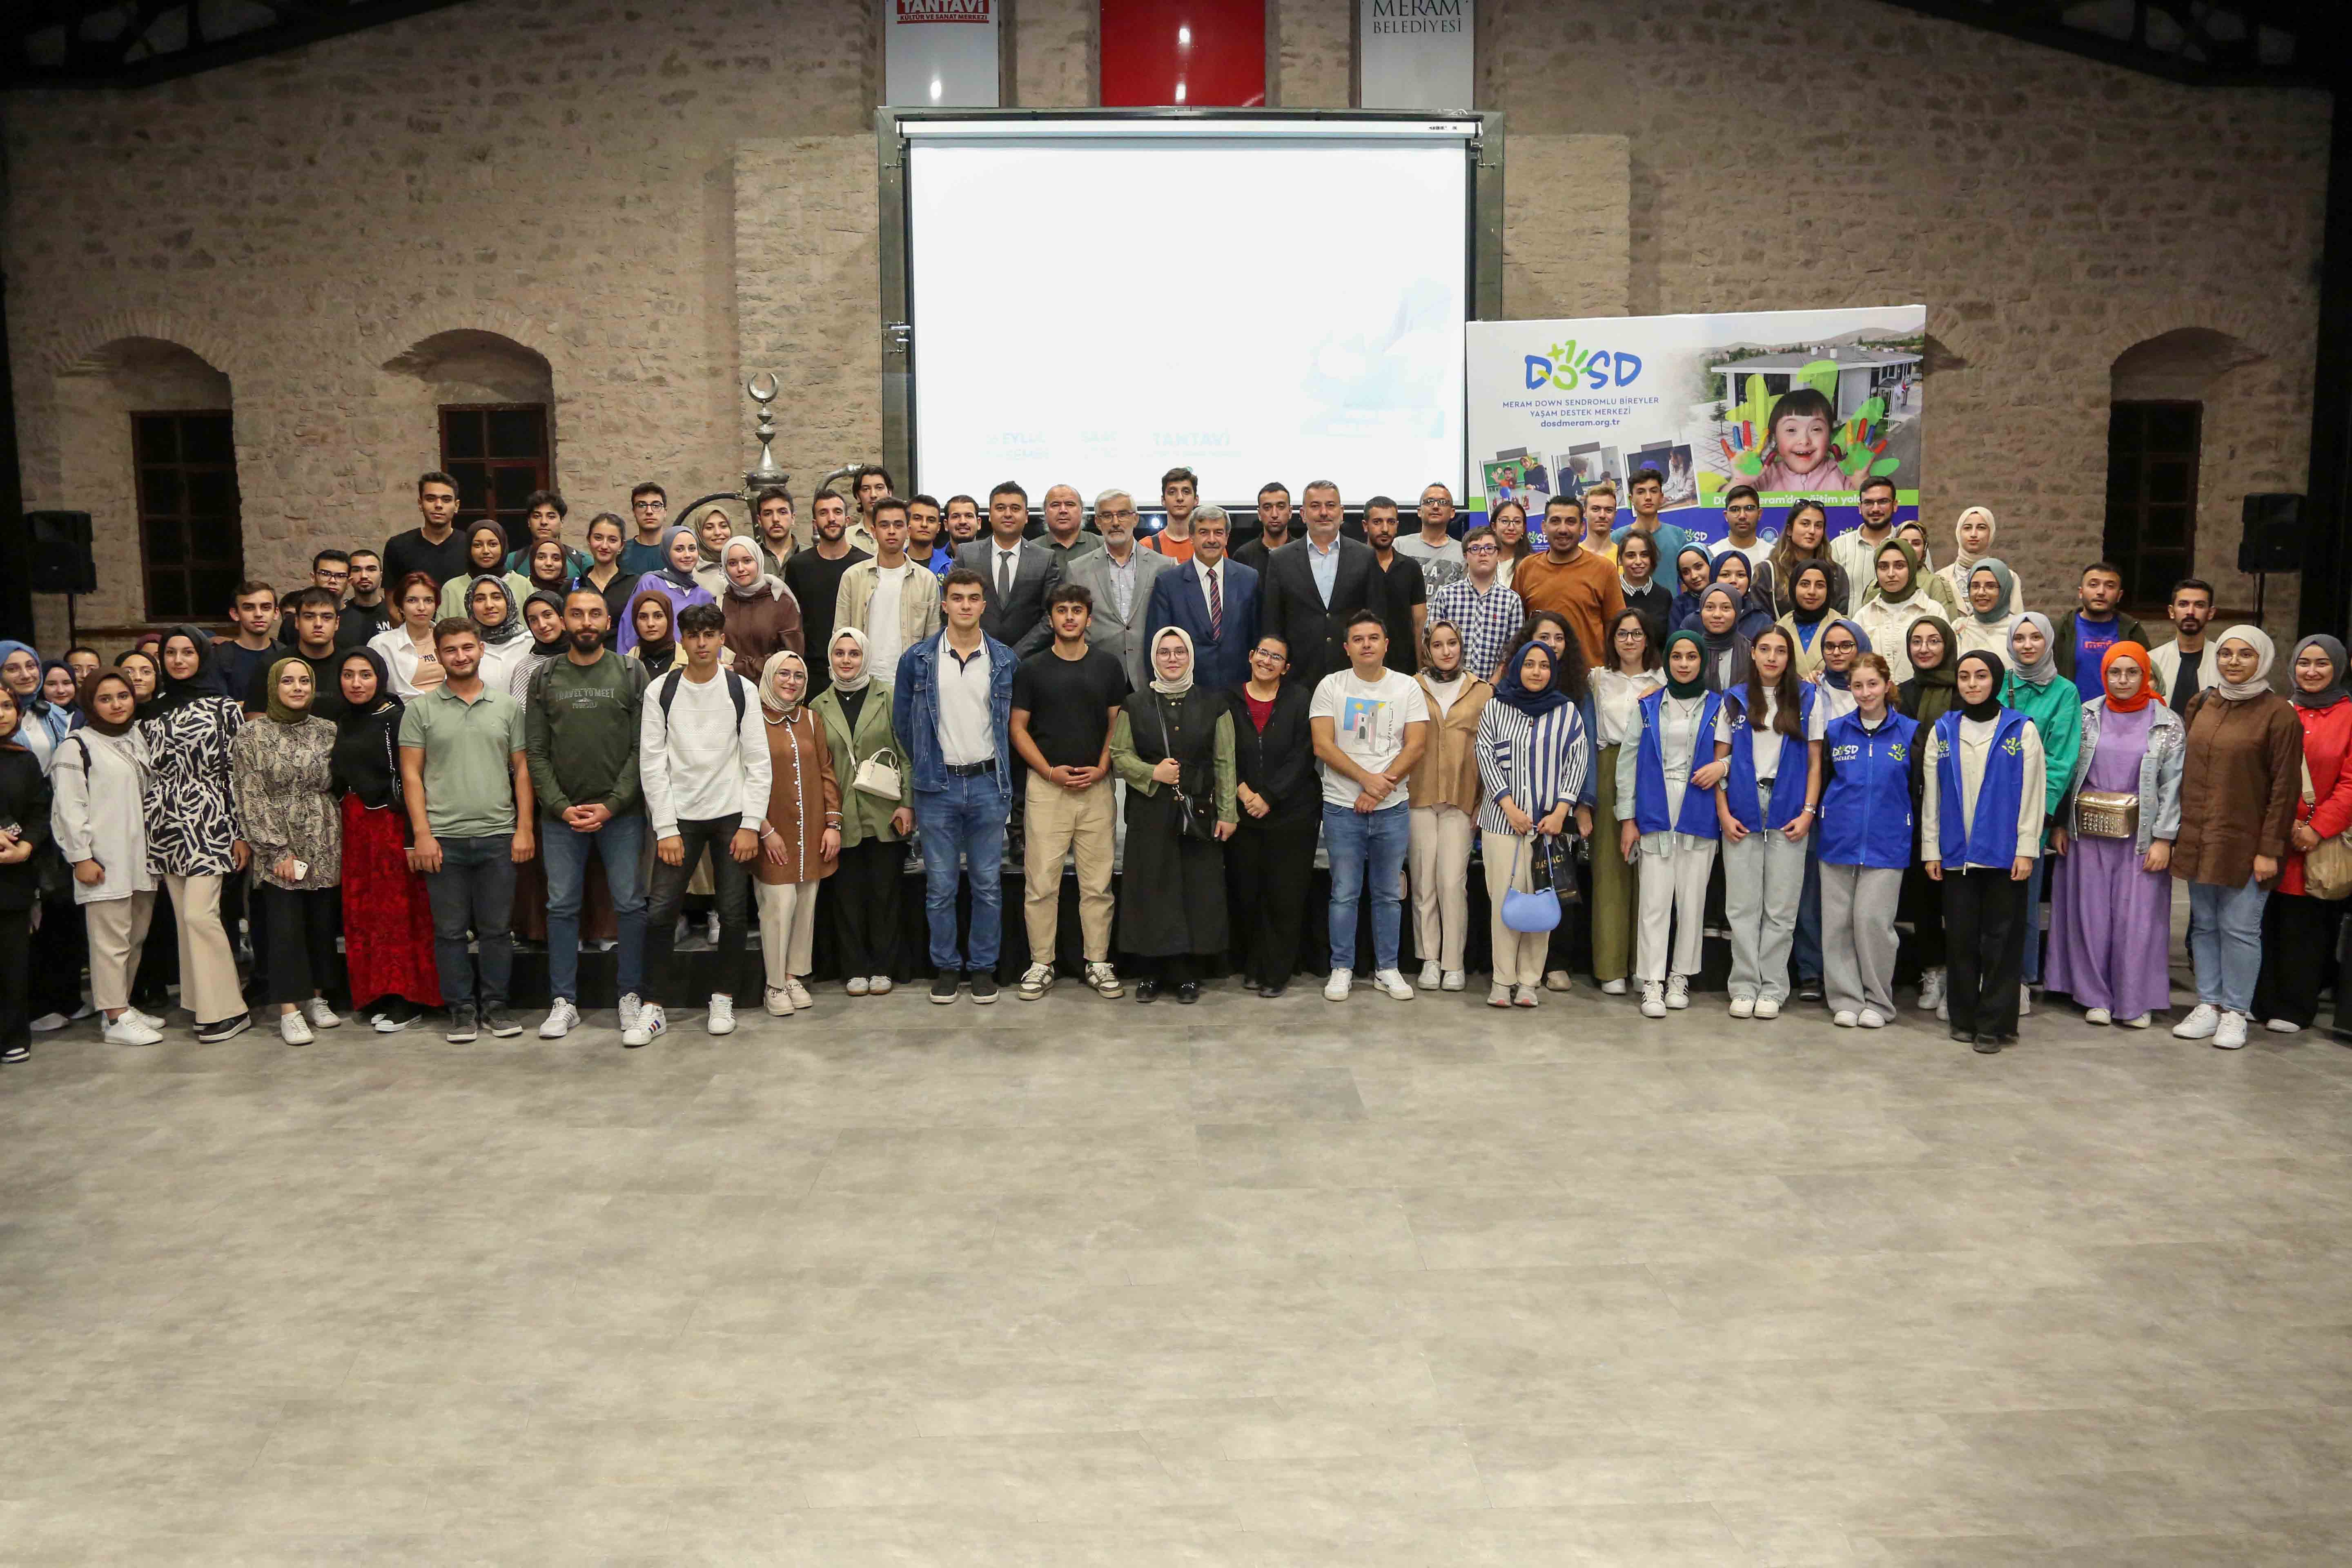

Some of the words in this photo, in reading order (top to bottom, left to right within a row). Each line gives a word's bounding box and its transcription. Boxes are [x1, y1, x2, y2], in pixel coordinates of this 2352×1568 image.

[1372, 0, 1461, 17] MERAM
[1373, 18, 1461, 34] BELEDİYESİ
[1565, 398, 1617, 406] SENDROMLU
[1619, 396, 1659, 405] BİREYLER
[1530, 410, 1558, 418] YAŞAM
[1595, 406, 1631, 415] MERKEZİ
[1541, 419, 1620, 428] dosdmeram.org.tr
